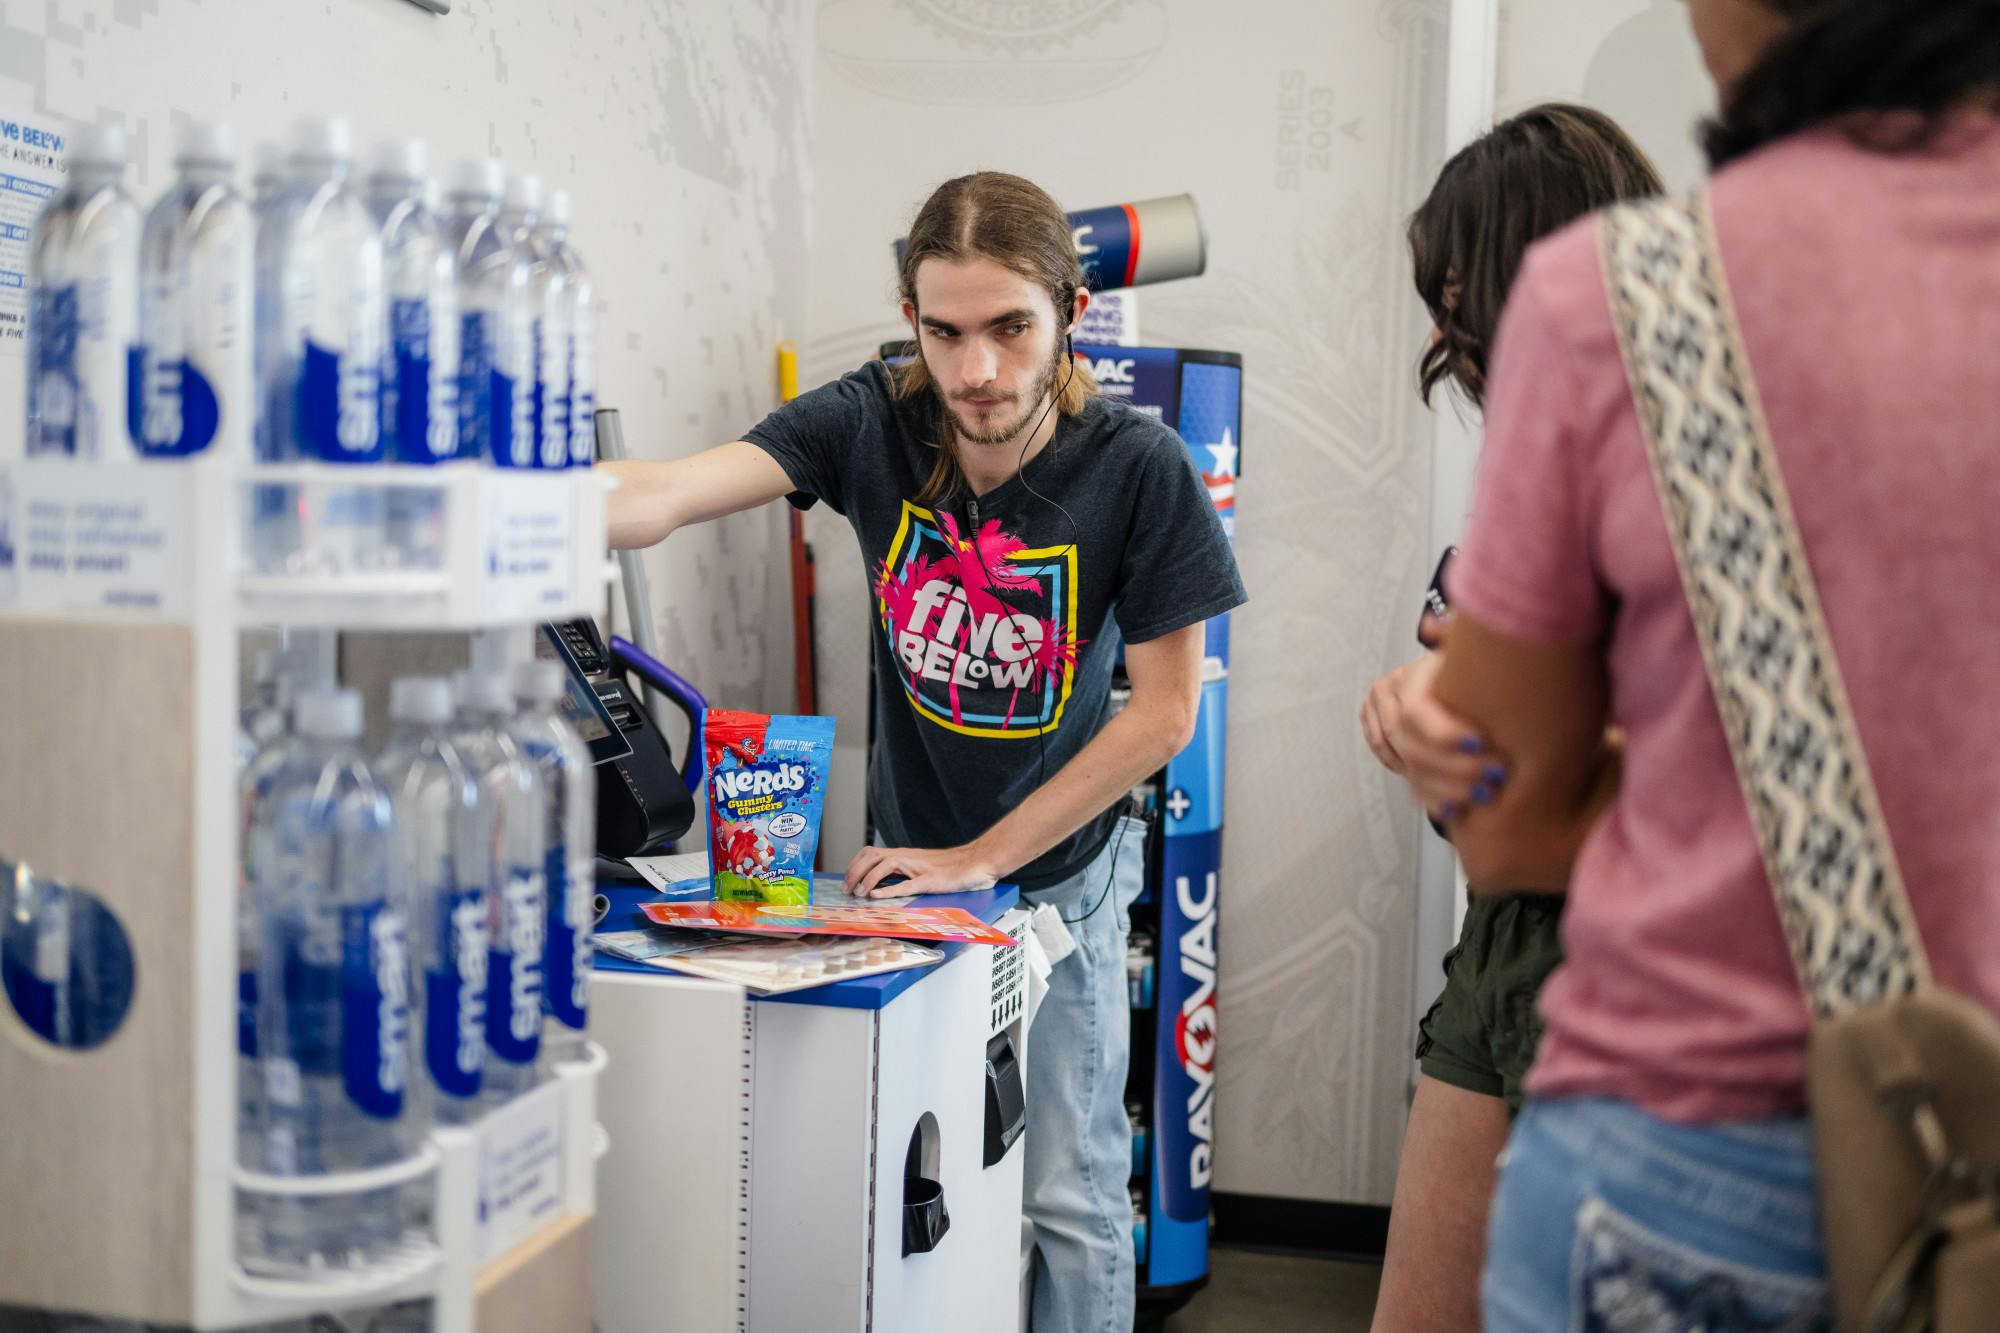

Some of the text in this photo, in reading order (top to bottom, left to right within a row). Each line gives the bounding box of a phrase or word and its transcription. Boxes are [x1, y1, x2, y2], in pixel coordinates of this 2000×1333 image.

[0, 121, 20, 141] ve
[1274, 69, 1306, 193] SERIES
[1306, 87, 1334, 173] 2003
[13, 148, 55, 170] ANSWER
[907, 579, 1044, 663] five
[898, 629, 1038, 690] BELOW
[767, 738, 798, 751] LIMITED
[727, 794, 774, 810] Gummy
[737, 801, 783, 816] Clusters
[1176, 871, 1217, 1190] RAYOVAC
